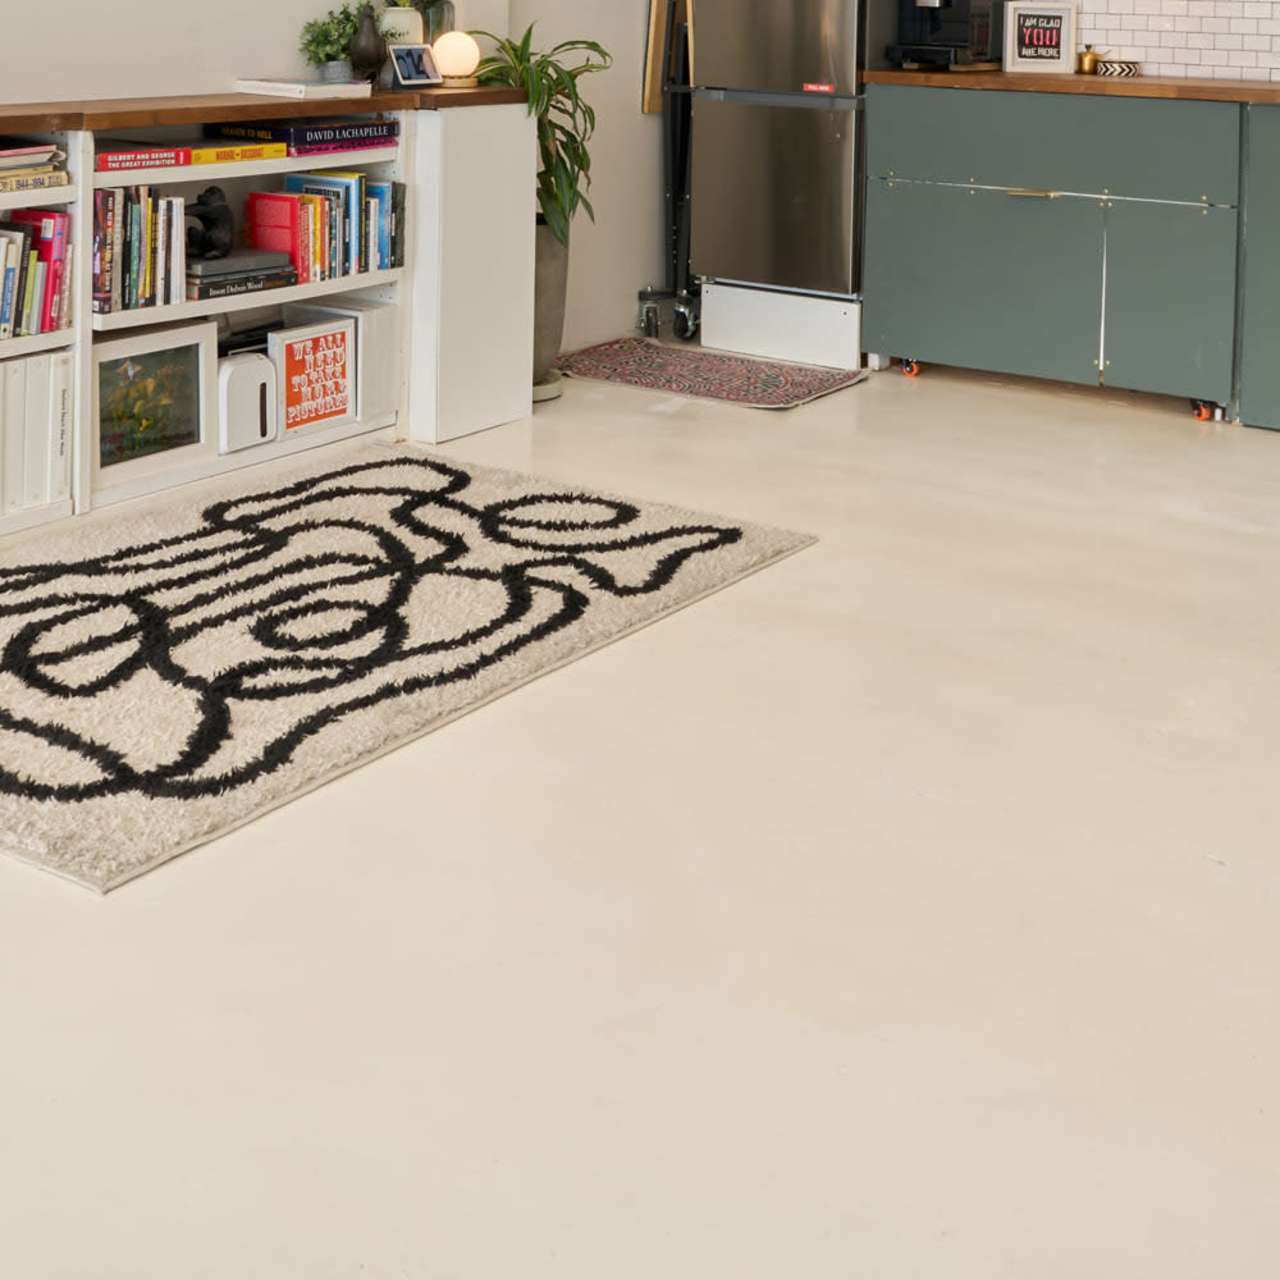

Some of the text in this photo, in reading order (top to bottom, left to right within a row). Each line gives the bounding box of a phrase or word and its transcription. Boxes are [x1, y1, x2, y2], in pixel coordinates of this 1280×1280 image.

[1038, 18, 1061, 28] GLAD
[1023, 28, 1057, 46] YOU
[306, 125, 389, 142] DAVID LACHAPELLE
